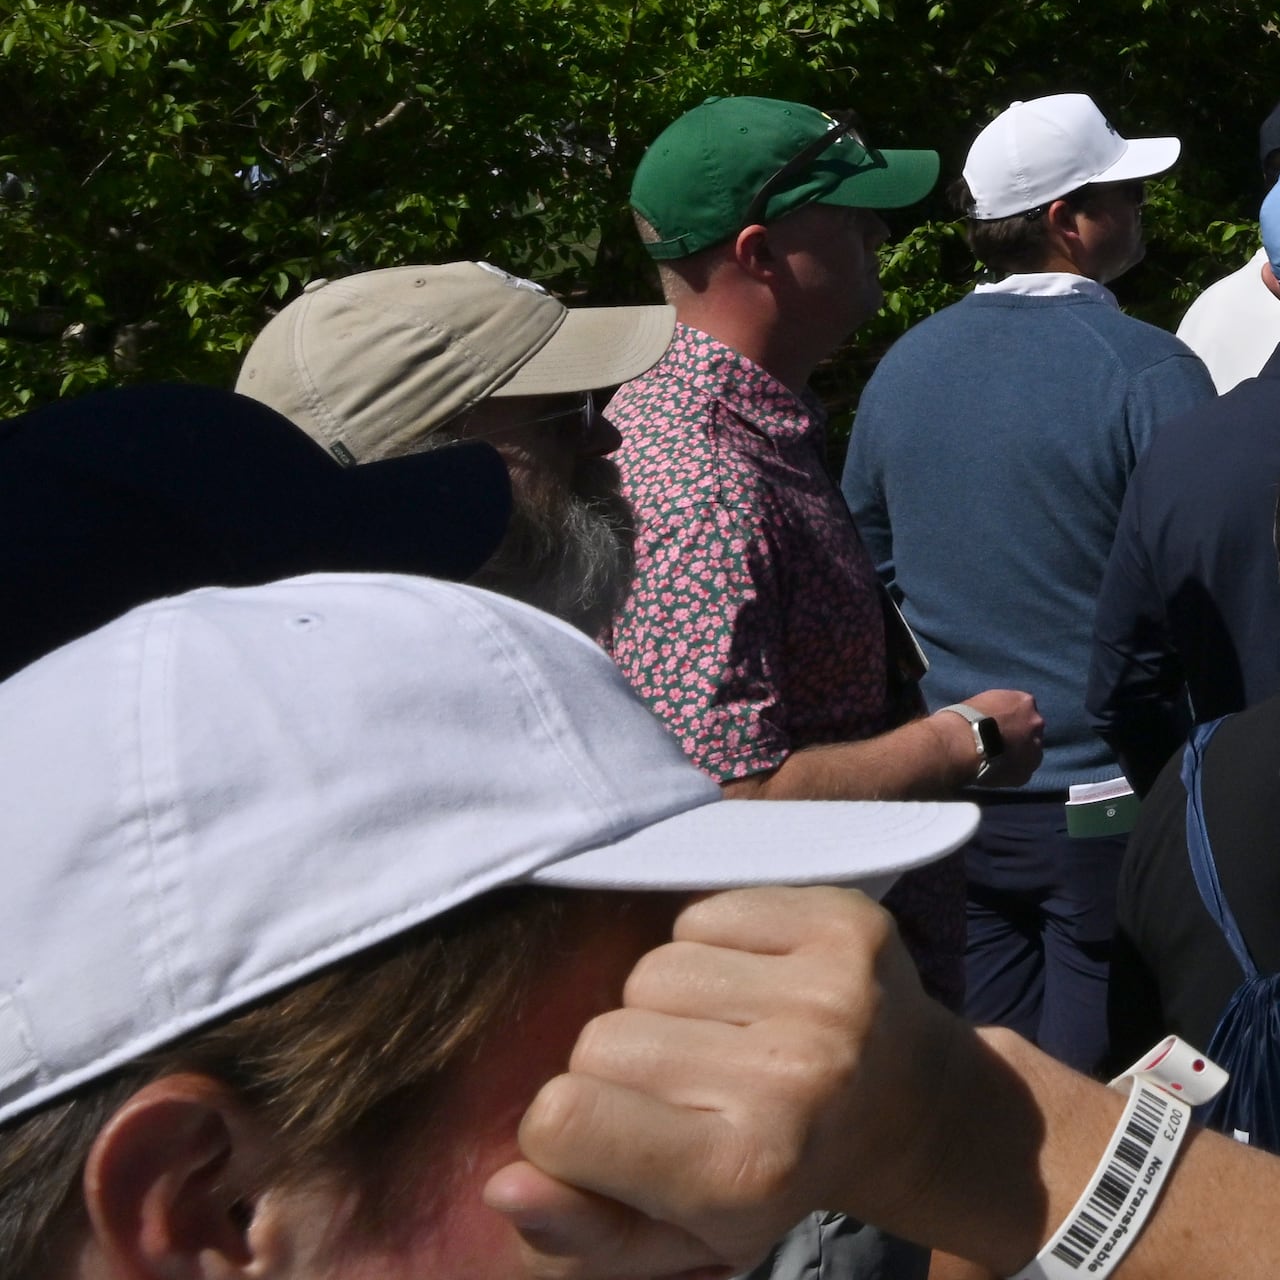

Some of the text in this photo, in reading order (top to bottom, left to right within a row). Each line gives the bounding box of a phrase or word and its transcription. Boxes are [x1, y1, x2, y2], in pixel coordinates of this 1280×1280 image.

[1087, 1108, 1183, 1273] 0073 Non transferable
